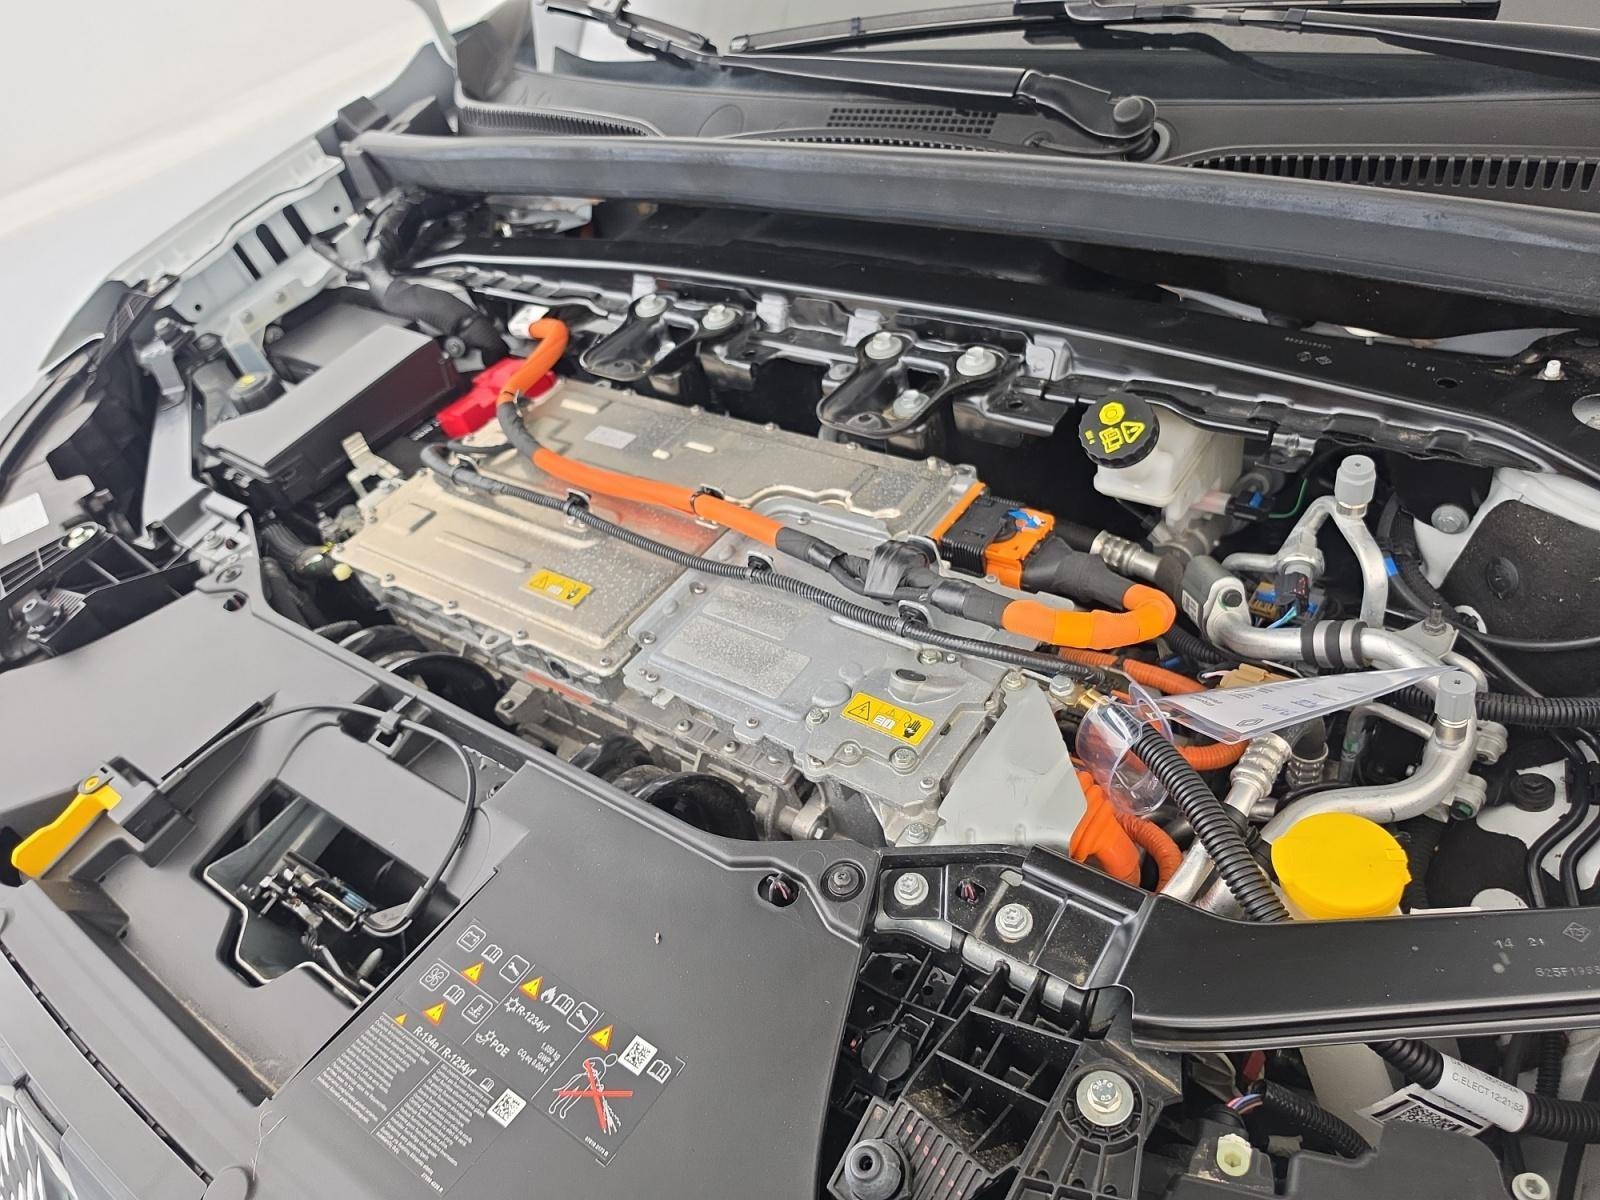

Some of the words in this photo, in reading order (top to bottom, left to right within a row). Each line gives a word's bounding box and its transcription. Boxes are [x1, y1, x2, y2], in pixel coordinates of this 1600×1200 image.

[516, 1005, 551, 1034] R-1234yf
[413, 1026, 440, 1051] R-134a
[441, 1047, 478, 1077] R-1234yf
[489, 1039, 511, 1058] POE
[537, 1051, 552, 1064] GWP
